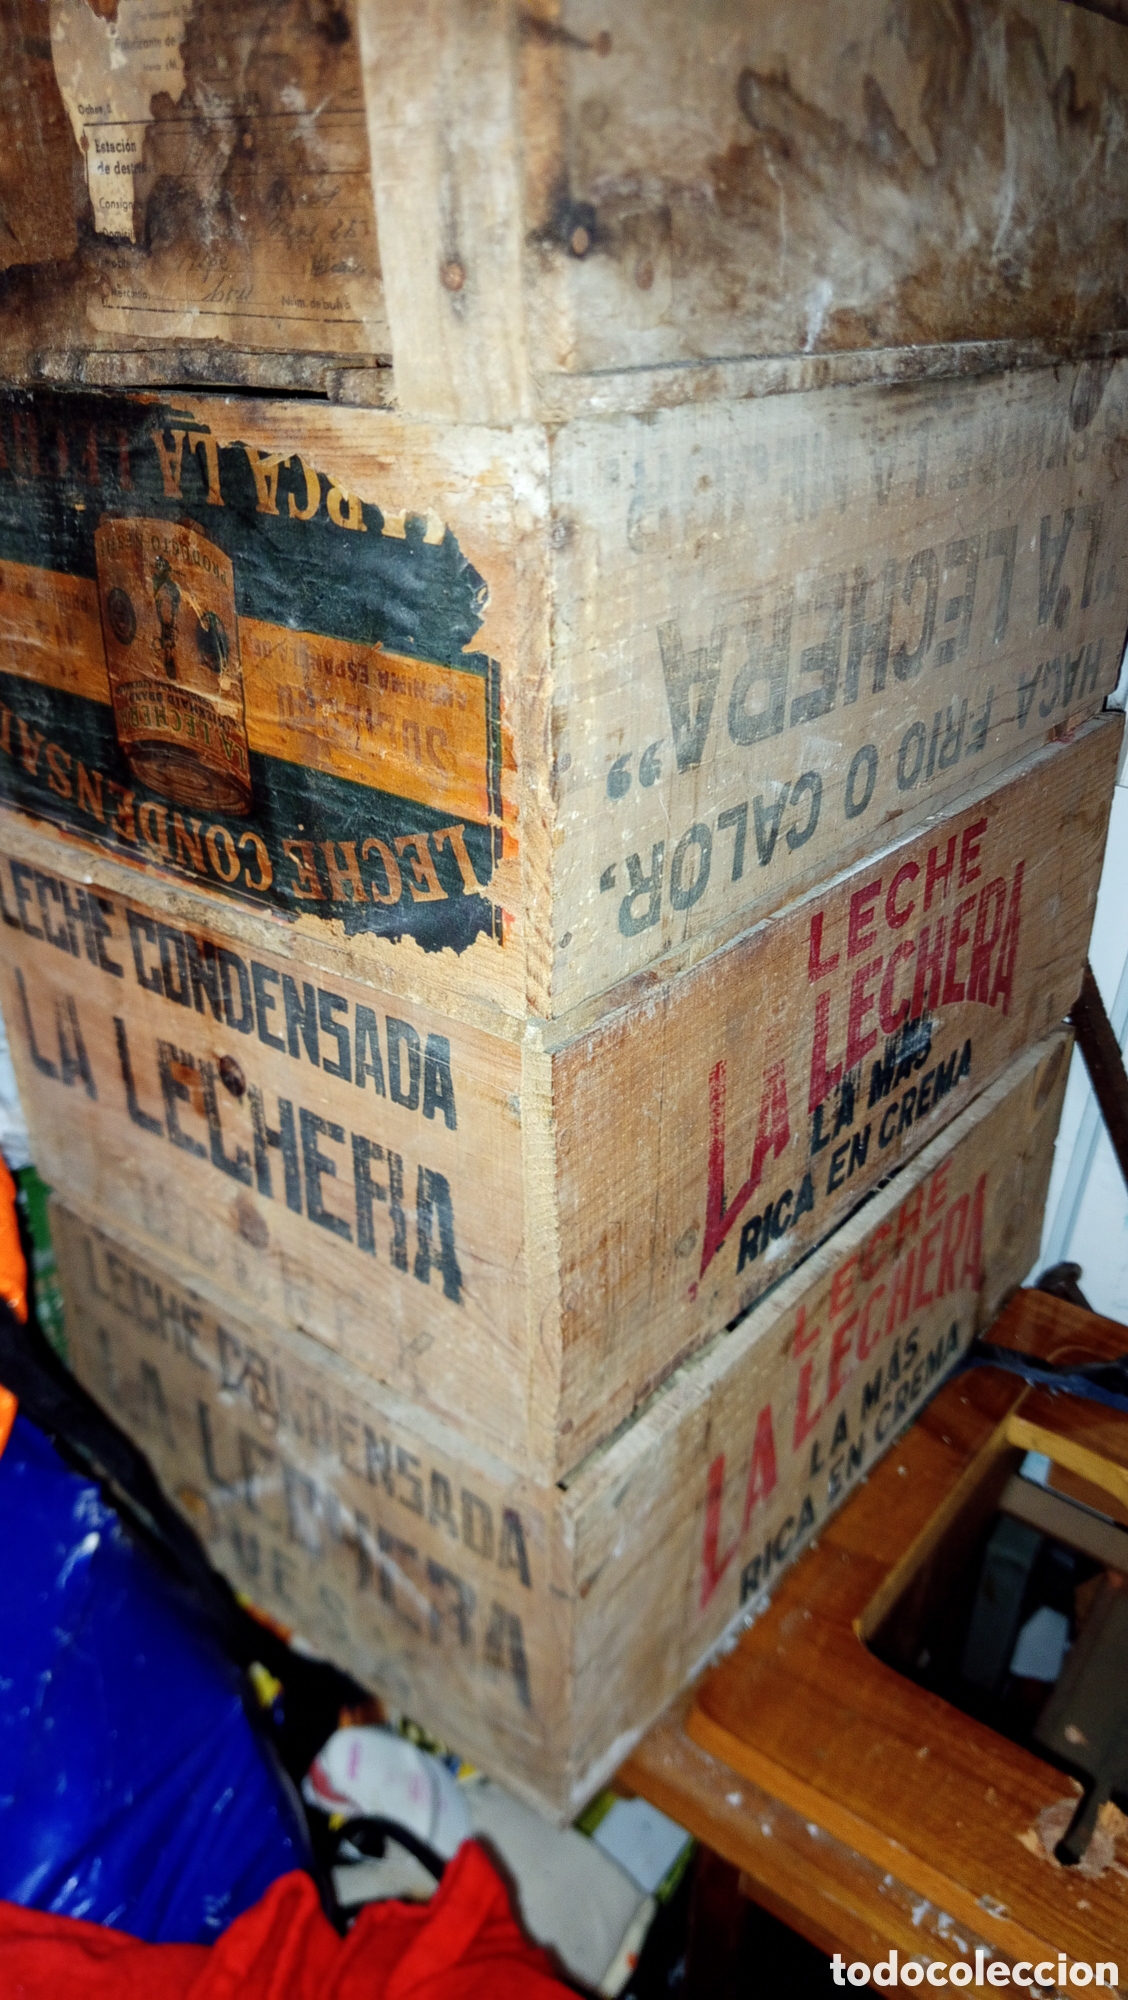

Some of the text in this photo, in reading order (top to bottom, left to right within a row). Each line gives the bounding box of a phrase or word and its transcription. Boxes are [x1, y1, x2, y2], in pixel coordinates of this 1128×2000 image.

[95, 138, 137, 155] Estación
[97, 160, 111, 175] de
[152, 428, 225, 506] LA
[118, 705, 246, 770] LA LECHERA
[843, 743, 879, 819] O
[897, 685, 994, 792] FRIO
[283, 823, 490, 906] LECHE
[808, 817, 988, 985] LECHE
[0, 858, 457, 1131] LECHE CONDENSADA
[14, 966, 98, 1102] LA
[700, 859, 1026, 1279] LA LECHERA
[811, 1083, 856, 1157] LA
[737, 1038, 972, 1275] RICA EN CREMA
[793, 1158, 954, 1359] LECHE
[701, 1173, 988, 1608] LA LECHERA
[738, 1322, 961, 1608] RICA EN CREMA
[810, 1411, 848, 1482] LA
